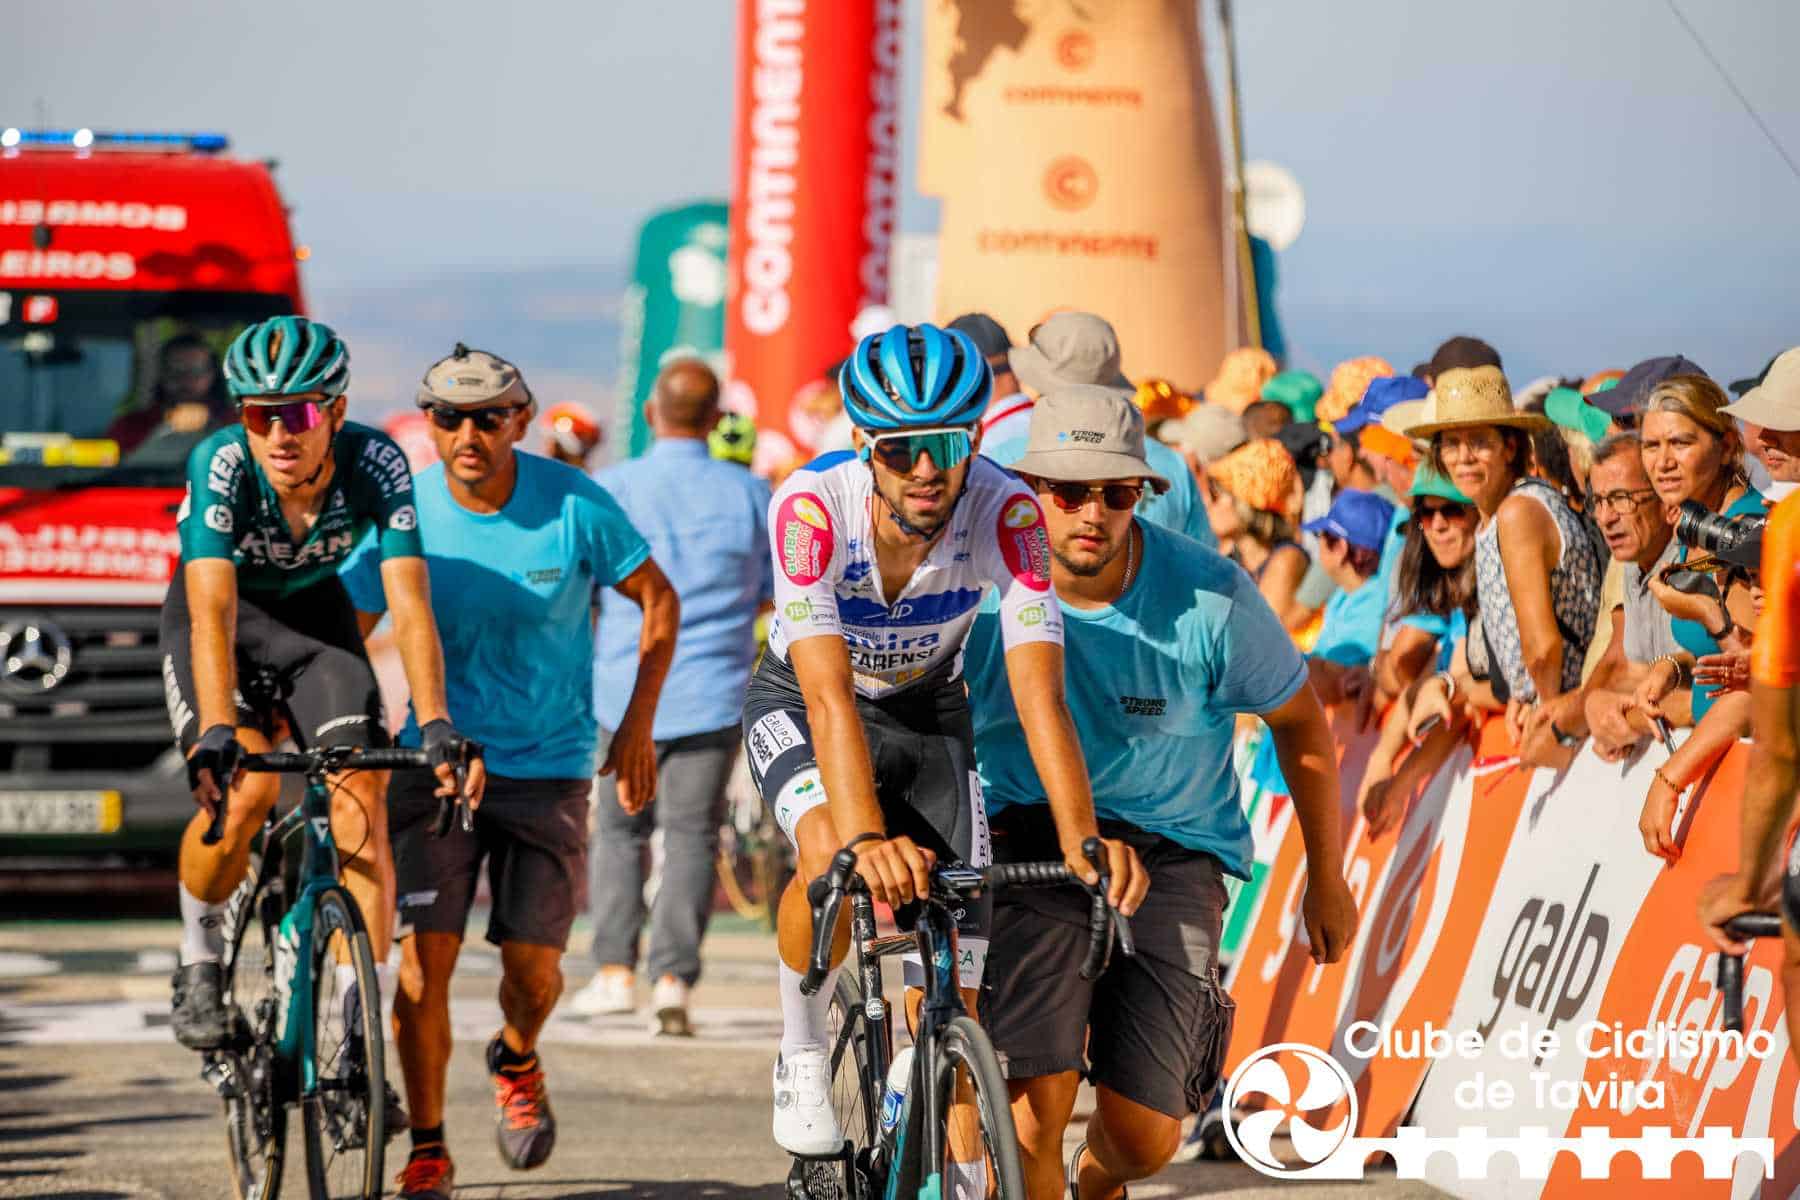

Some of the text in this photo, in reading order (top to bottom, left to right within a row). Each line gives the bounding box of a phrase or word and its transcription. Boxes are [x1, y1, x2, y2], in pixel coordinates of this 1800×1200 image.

[363, 438, 412, 494] KERN
[765, 714, 793, 747] GRUPO
[1476, 862, 1610, 1068] galp
